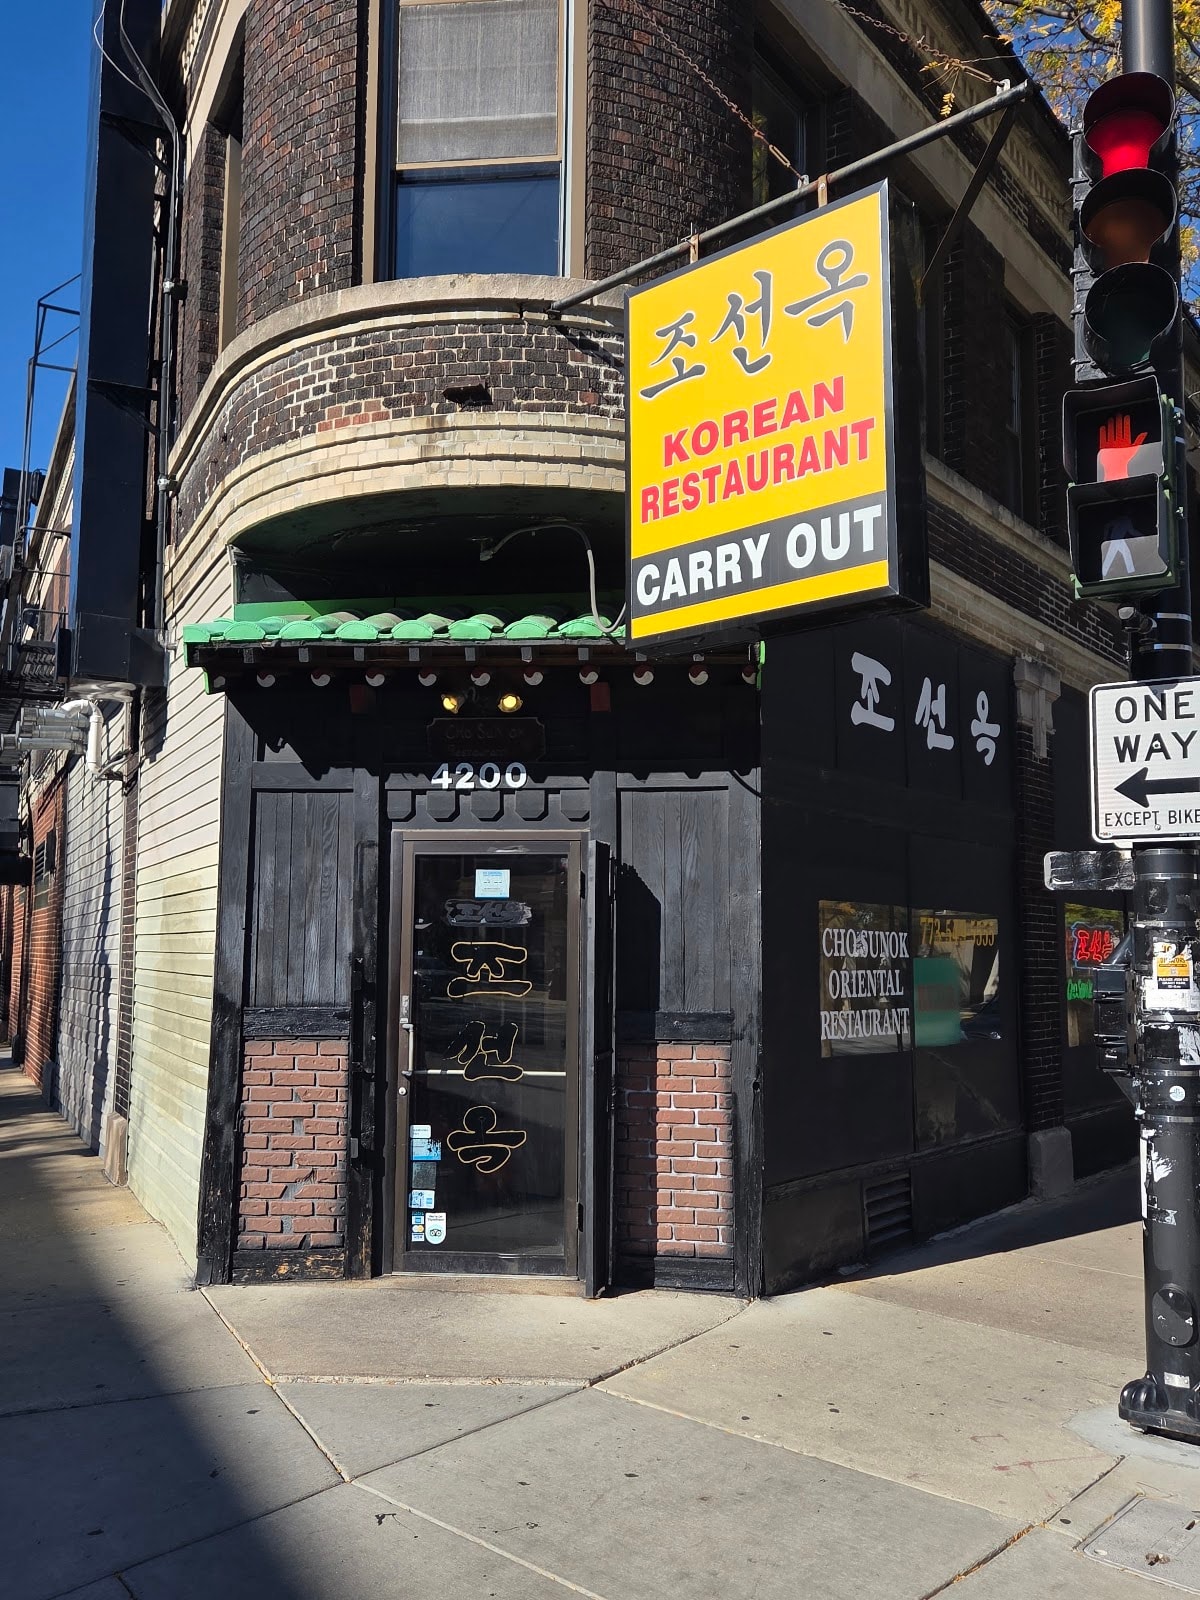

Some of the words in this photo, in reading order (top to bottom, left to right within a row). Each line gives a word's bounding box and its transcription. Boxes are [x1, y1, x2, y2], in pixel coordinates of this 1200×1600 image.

[640, 238, 869, 400] 조선옥
[663, 376, 844, 468] KOREAN
[641, 417, 875, 524] RESTAURANT
[636, 532, 771, 606] CARRY
[786, 503, 882, 570] OUT
[851, 652, 1000, 766] 조선옥
[1115, 691, 1195, 724] ONE
[1113, 730, 1198, 763] WAY
[431, 762, 527, 790] 4200
[1105, 810, 1159, 827] EXCEPT
[829, 969, 904, 999] ORIENTAL
[820, 1007, 910, 1040] RESTAURANT
